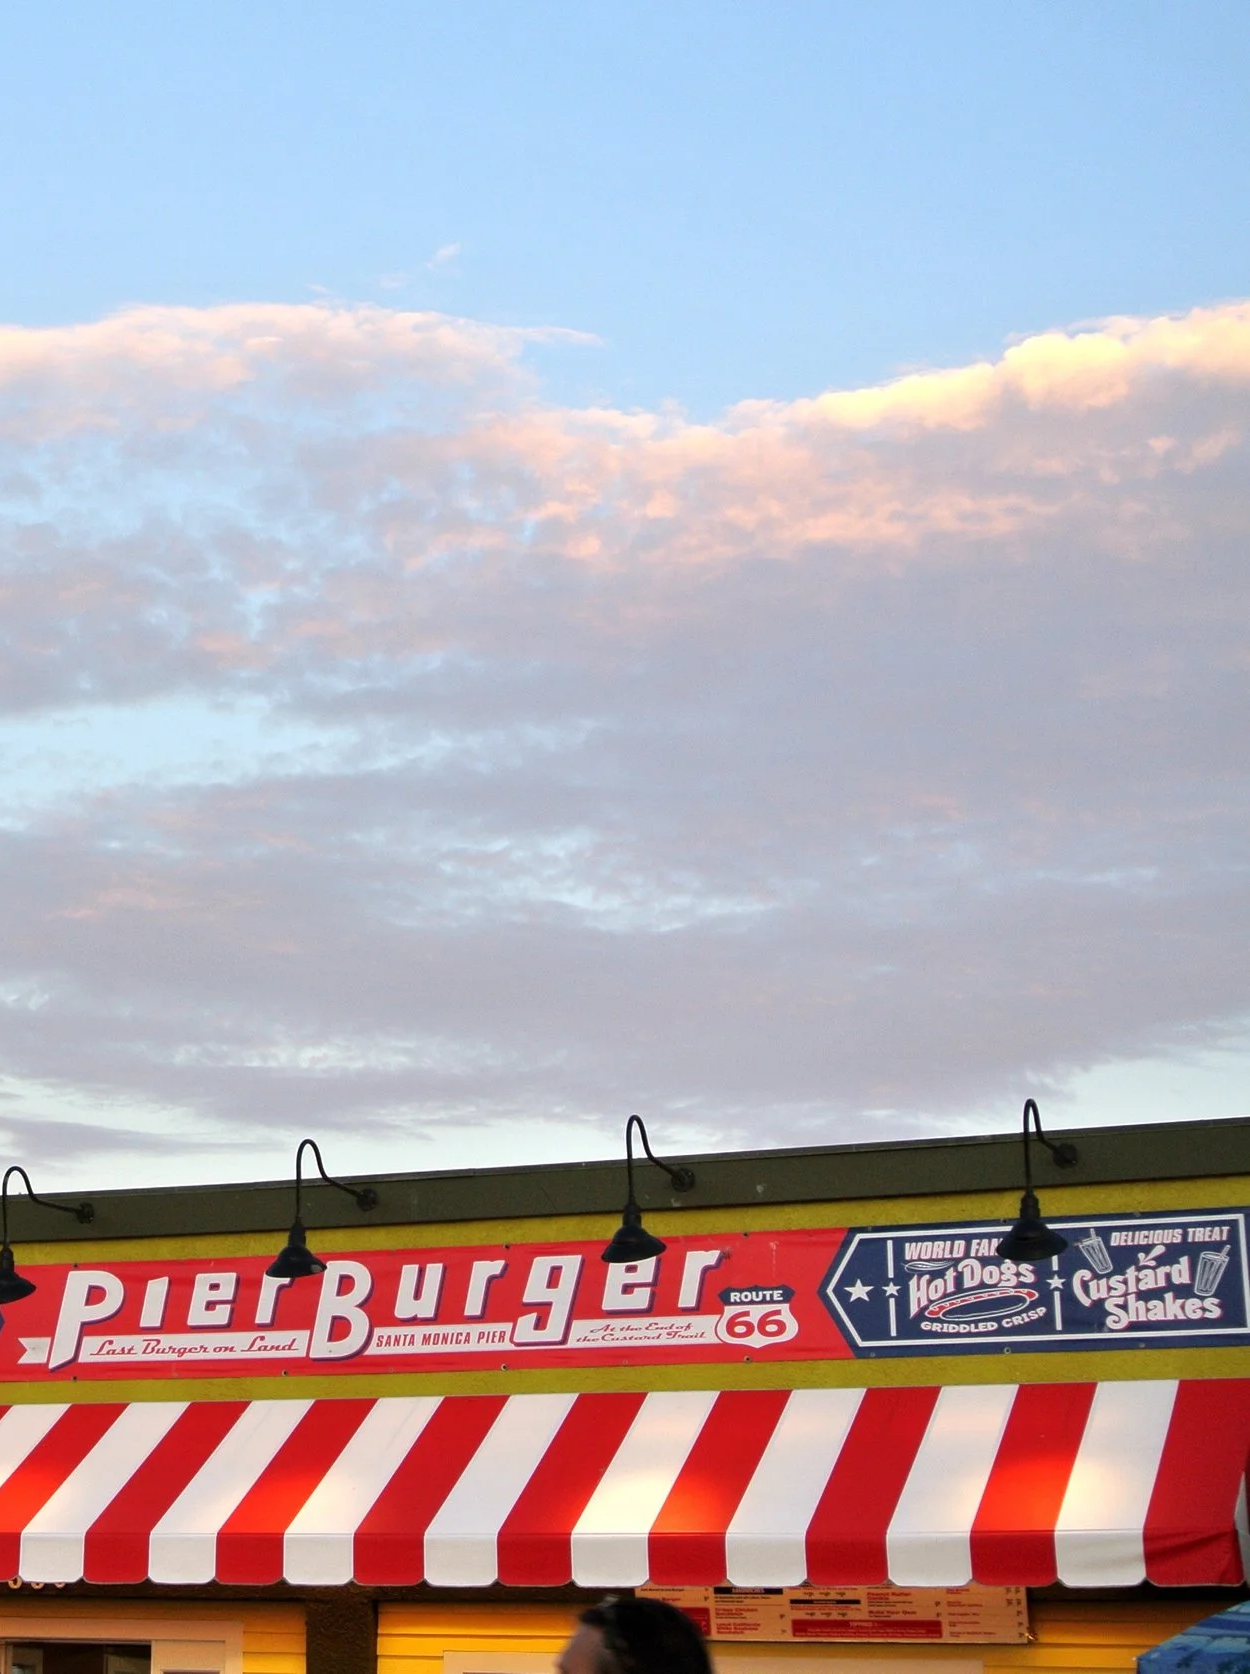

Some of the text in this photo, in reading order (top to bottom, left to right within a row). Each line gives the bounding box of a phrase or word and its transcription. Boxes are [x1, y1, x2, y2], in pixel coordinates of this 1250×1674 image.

[1110, 1226, 1230, 1246] DELICIOUS TREAT
[904, 1240, 965, 1260] WORLD
[909, 1259, 1036, 1319] Hot Dogs
[1072, 1255, 1191, 1307] Custard
[729, 1289, 784, 1303] ROUTE
[920, 1307, 1047, 1333] GRIDDLED CRISP
[1104, 1293, 1222, 1331] Shakes
[589, 1321, 694, 1334] At the End of
[725, 1309, 788, 1339] 66
[90, 1335, 299, 1357] Last Burger on Land
[376, 1330, 506, 1348] SANTA MONICA PIER
[576, 1331, 706, 1343] the Custard Trail
